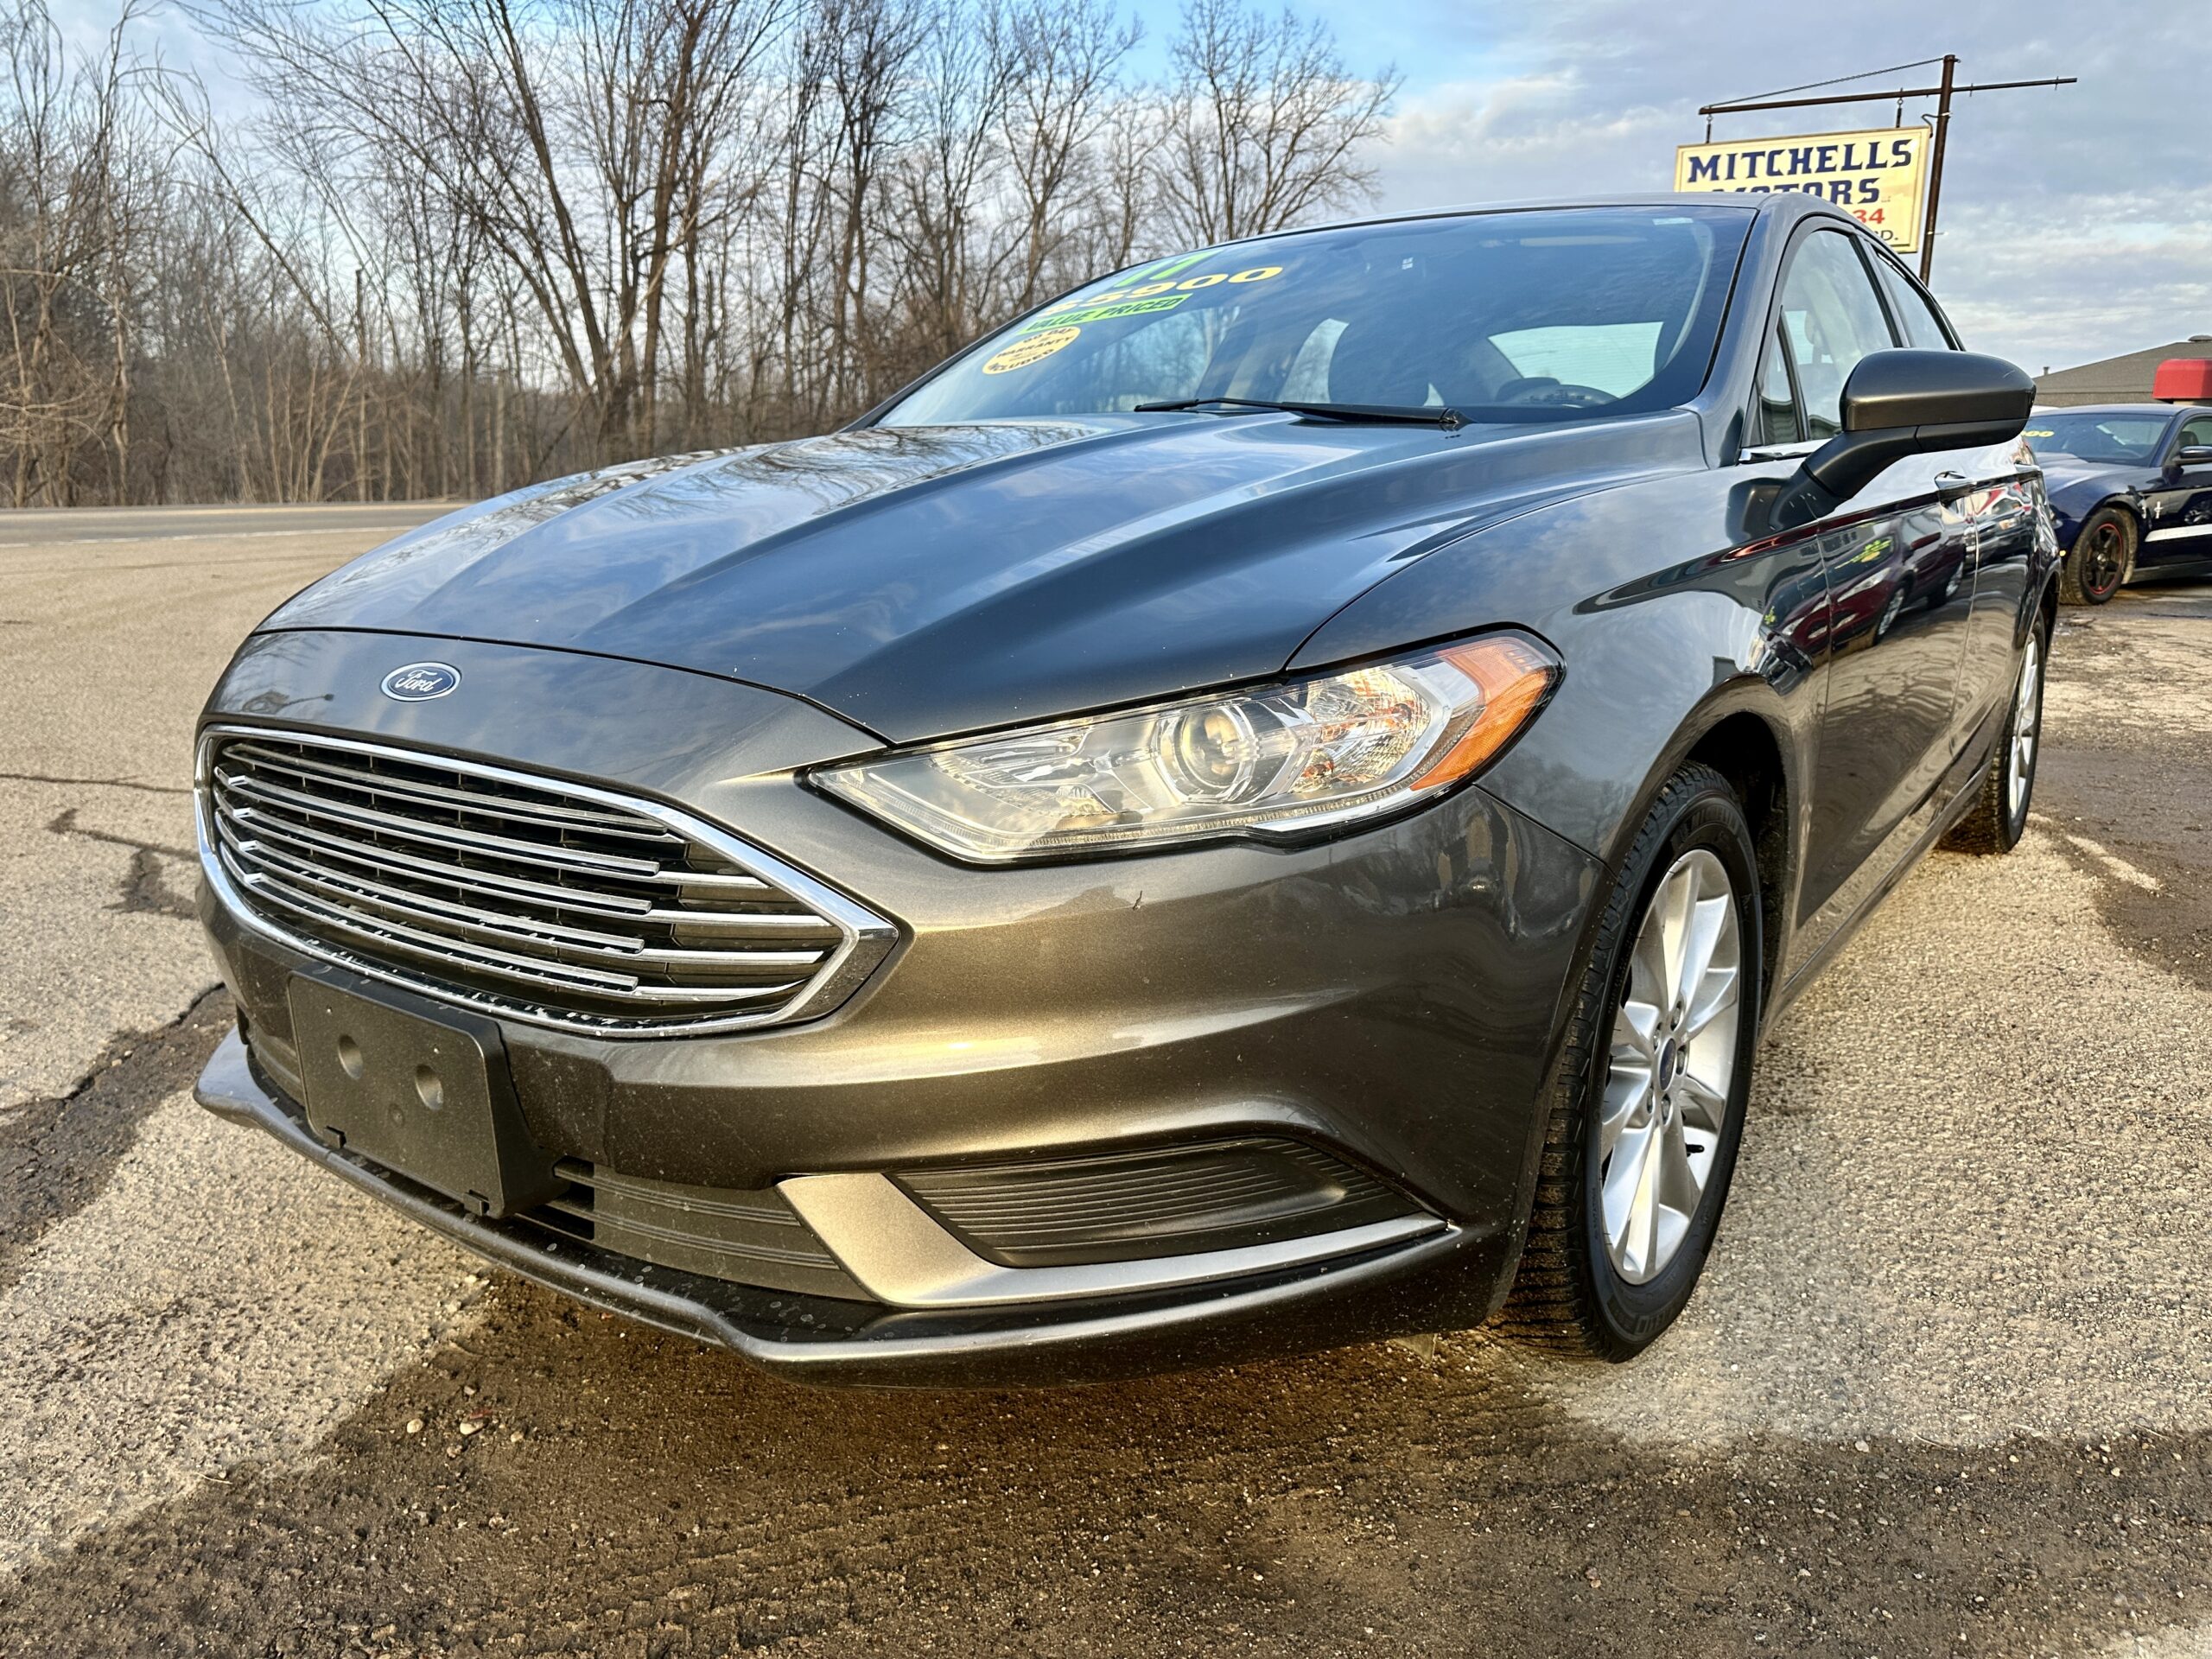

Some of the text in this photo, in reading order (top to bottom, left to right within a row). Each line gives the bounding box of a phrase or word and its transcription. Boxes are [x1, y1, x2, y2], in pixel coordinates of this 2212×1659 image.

[1688, 139, 1912, 183] MITCHELLS
[1094, 297, 1185, 319] PRICED
[395, 669, 443, 692] Ford
